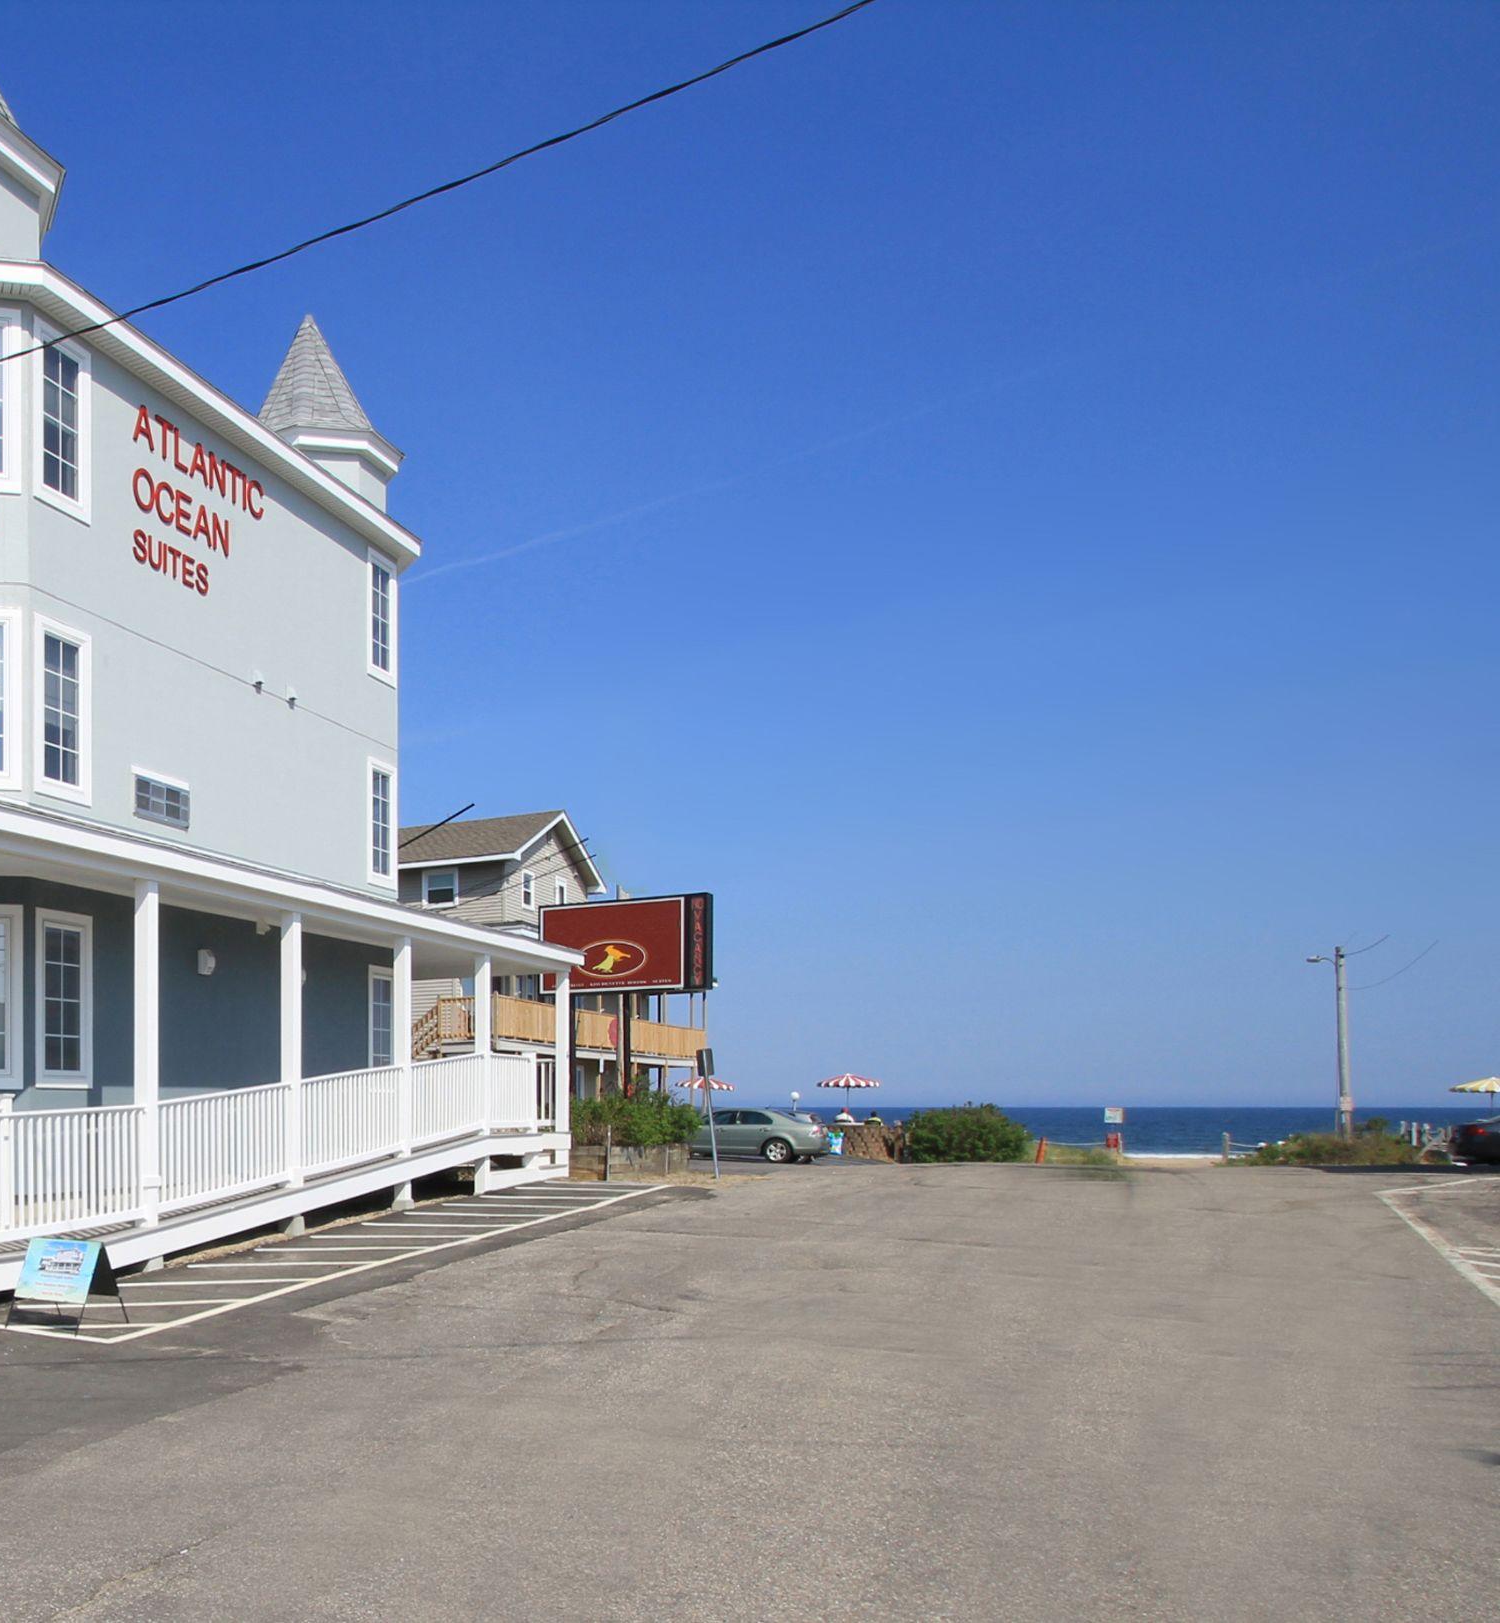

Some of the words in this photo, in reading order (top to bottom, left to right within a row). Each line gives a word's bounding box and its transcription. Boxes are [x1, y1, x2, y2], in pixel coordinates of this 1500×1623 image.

[133, 404, 265, 520] ATLANTIC
[132, 467, 230, 558] OCEAN
[132, 529, 210, 596] SUITES
